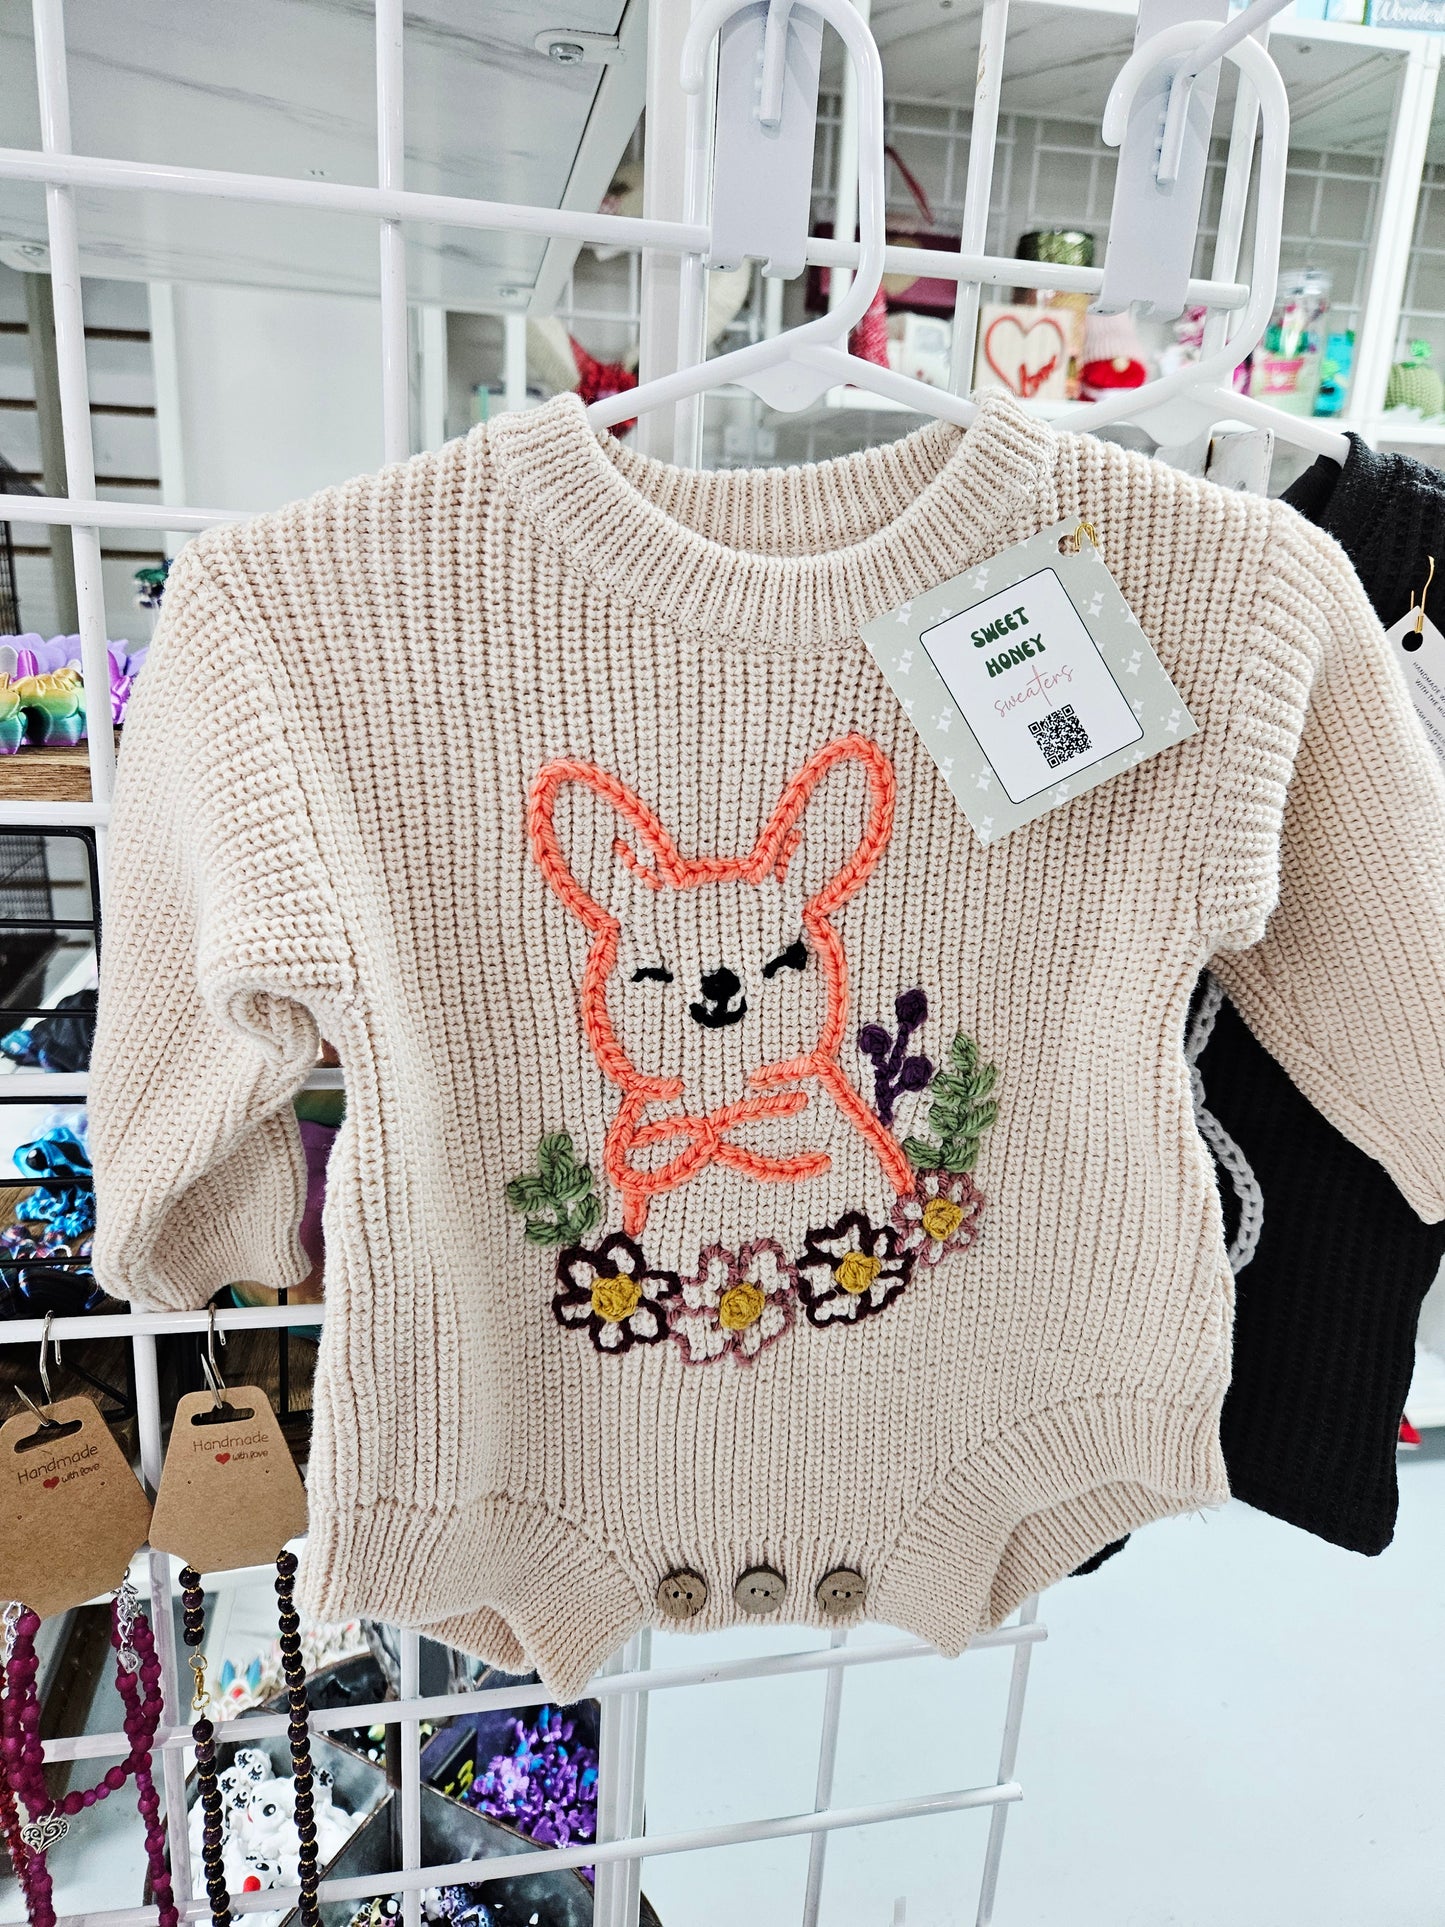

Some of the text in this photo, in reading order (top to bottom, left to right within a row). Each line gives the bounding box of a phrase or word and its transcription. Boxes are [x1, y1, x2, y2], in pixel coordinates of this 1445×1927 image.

[970, 606, 1029, 648] SWEET
[984, 633, 1046, 678] HONEY
[994, 664, 1074, 718] sweaters
[193, 1431, 269, 1452] Handmade
[232, 1450, 269, 1461] with love
[17, 1444, 98, 1484] Handmade
[61, 1463, 100, 1483] with love
